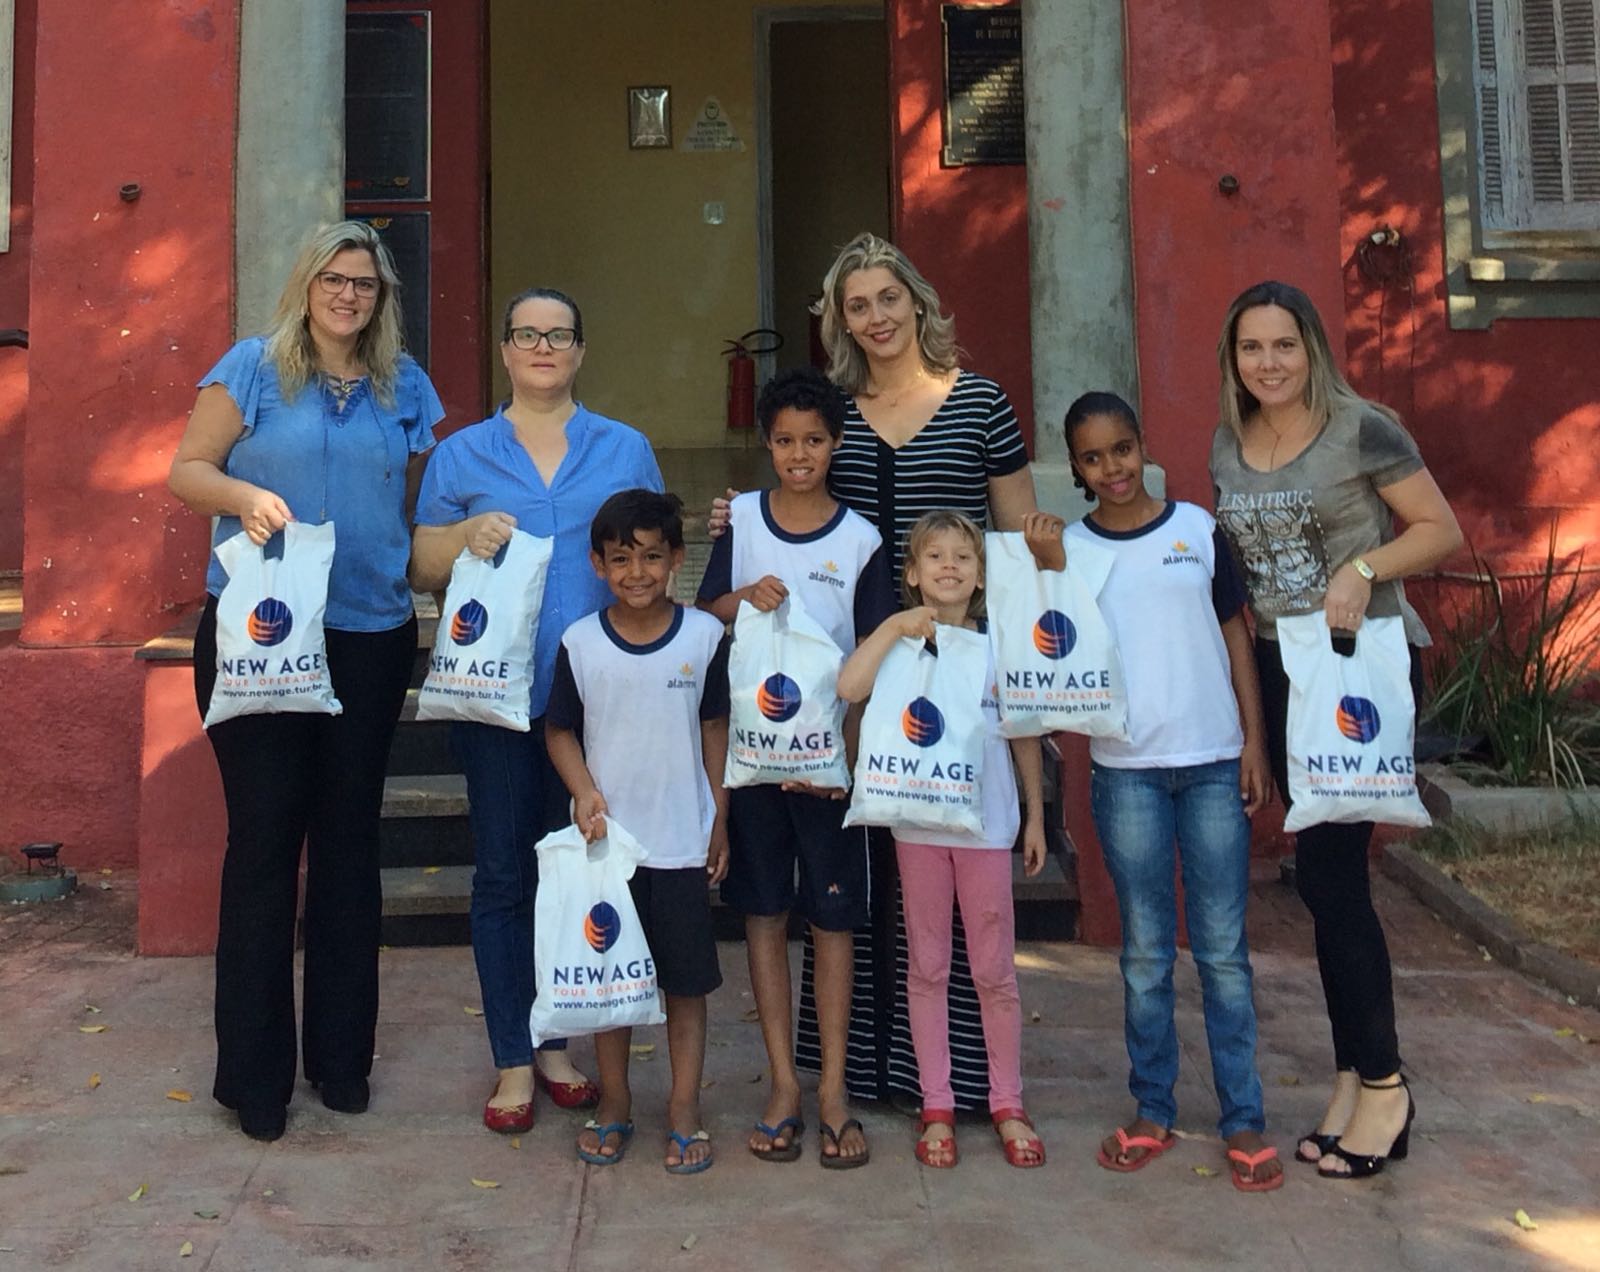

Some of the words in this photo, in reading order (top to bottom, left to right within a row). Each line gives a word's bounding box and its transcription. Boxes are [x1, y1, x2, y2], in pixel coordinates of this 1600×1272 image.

[808, 571, 846, 589] alarme
[222, 658, 268, 676] NEW
[280, 653, 321, 674] AGE
[431, 656, 459, 673] NEW
[467, 659, 509, 679] AGE
[223, 677, 249, 687] OUR
[449, 676, 508, 689] OPERATOR
[1006, 671, 1055, 689] NEW
[1065, 670, 1110, 689] AGE
[222, 683, 323, 697] www.newage.tur.br
[1006, 690, 1035, 699] TOUR
[1045, 690, 1111, 700] OPERATOR
[1006, 702, 1111, 714] www.newage.tur.br
[735, 727, 777, 750] NEW
[789, 731, 833, 751] AGE
[868, 753, 920, 776] NEW
[931, 762, 974, 782] AGE
[1307, 755, 1362, 774] NEW
[1376, 755, 1413, 774] AGE
[866, 774, 898, 785] TOUR
[908, 778, 973, 793] OPERATOR
[866, 786, 972, 805] www.newage.tur.br
[553, 966, 605, 985] NEW
[612, 958, 653, 981] AGE
[553, 988, 586, 997] TOUR
[553, 990, 655, 1010] www.newage.tur.br
